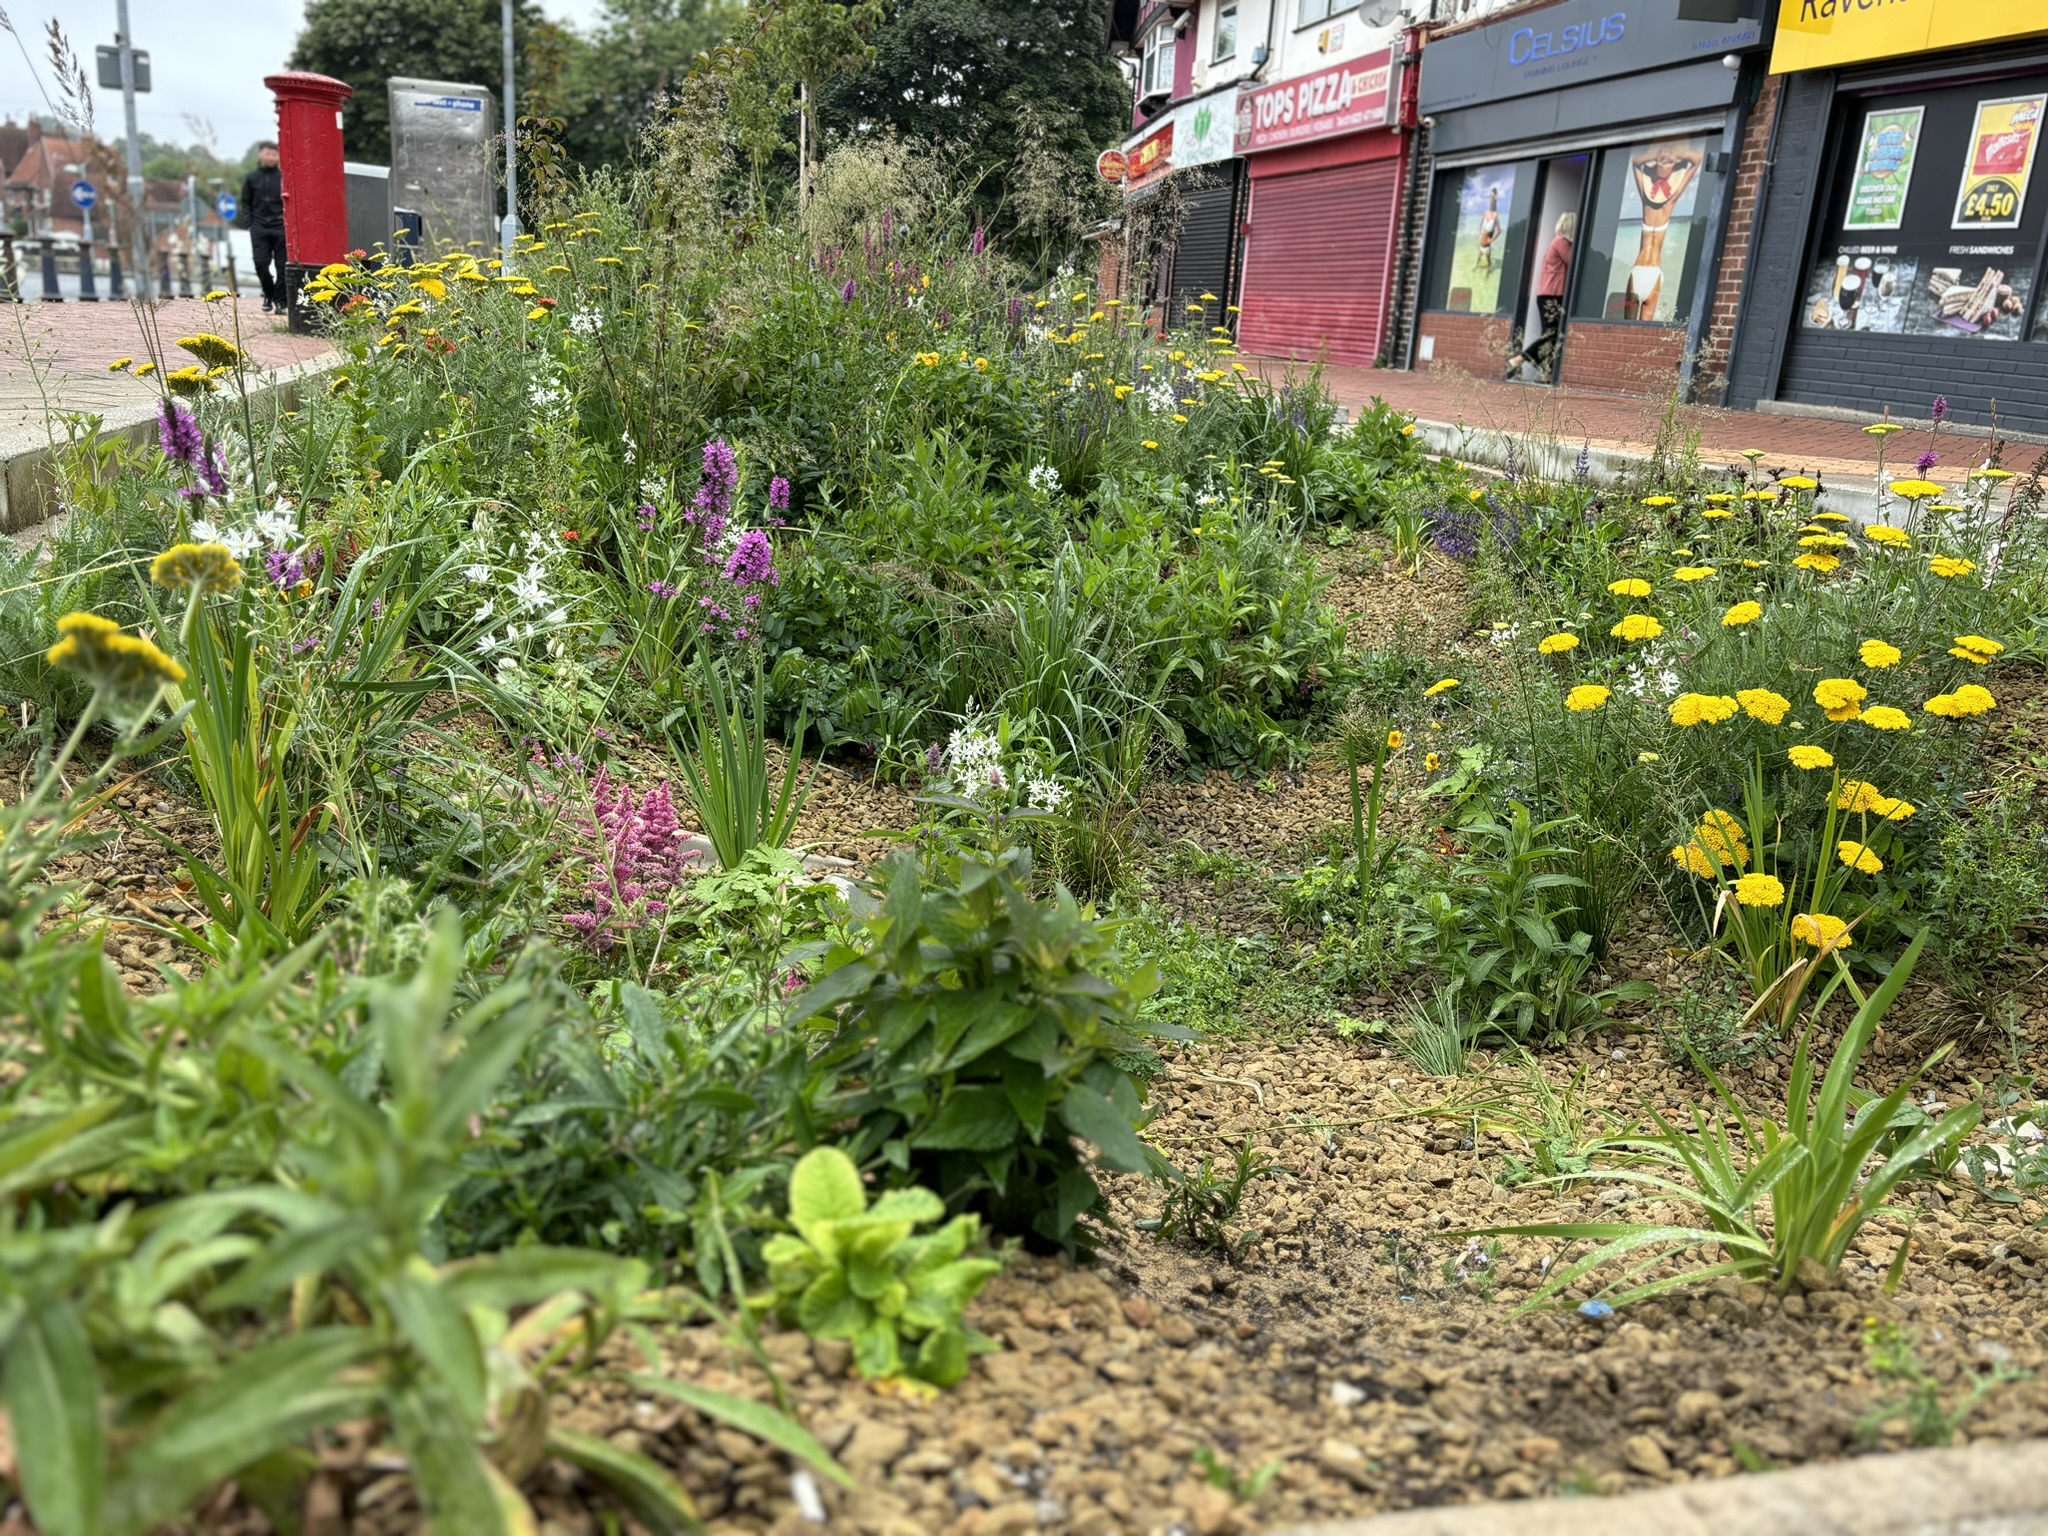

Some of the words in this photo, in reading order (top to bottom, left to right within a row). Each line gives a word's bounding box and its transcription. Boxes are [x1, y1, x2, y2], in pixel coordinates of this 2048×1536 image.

[1255, 86, 1295, 131] TOPS
[1296, 68, 1351, 122] PIZZA
[1964, 192, 2015, 217] £4.50
[1838, 245, 1860, 254] CHILLED
[1860, 245, 1875, 254] BEER
[1881, 245, 1898, 254] WINE
[1949, 245, 1968, 254] FRESH
[1968, 245, 2015, 255] SANDWICHES
